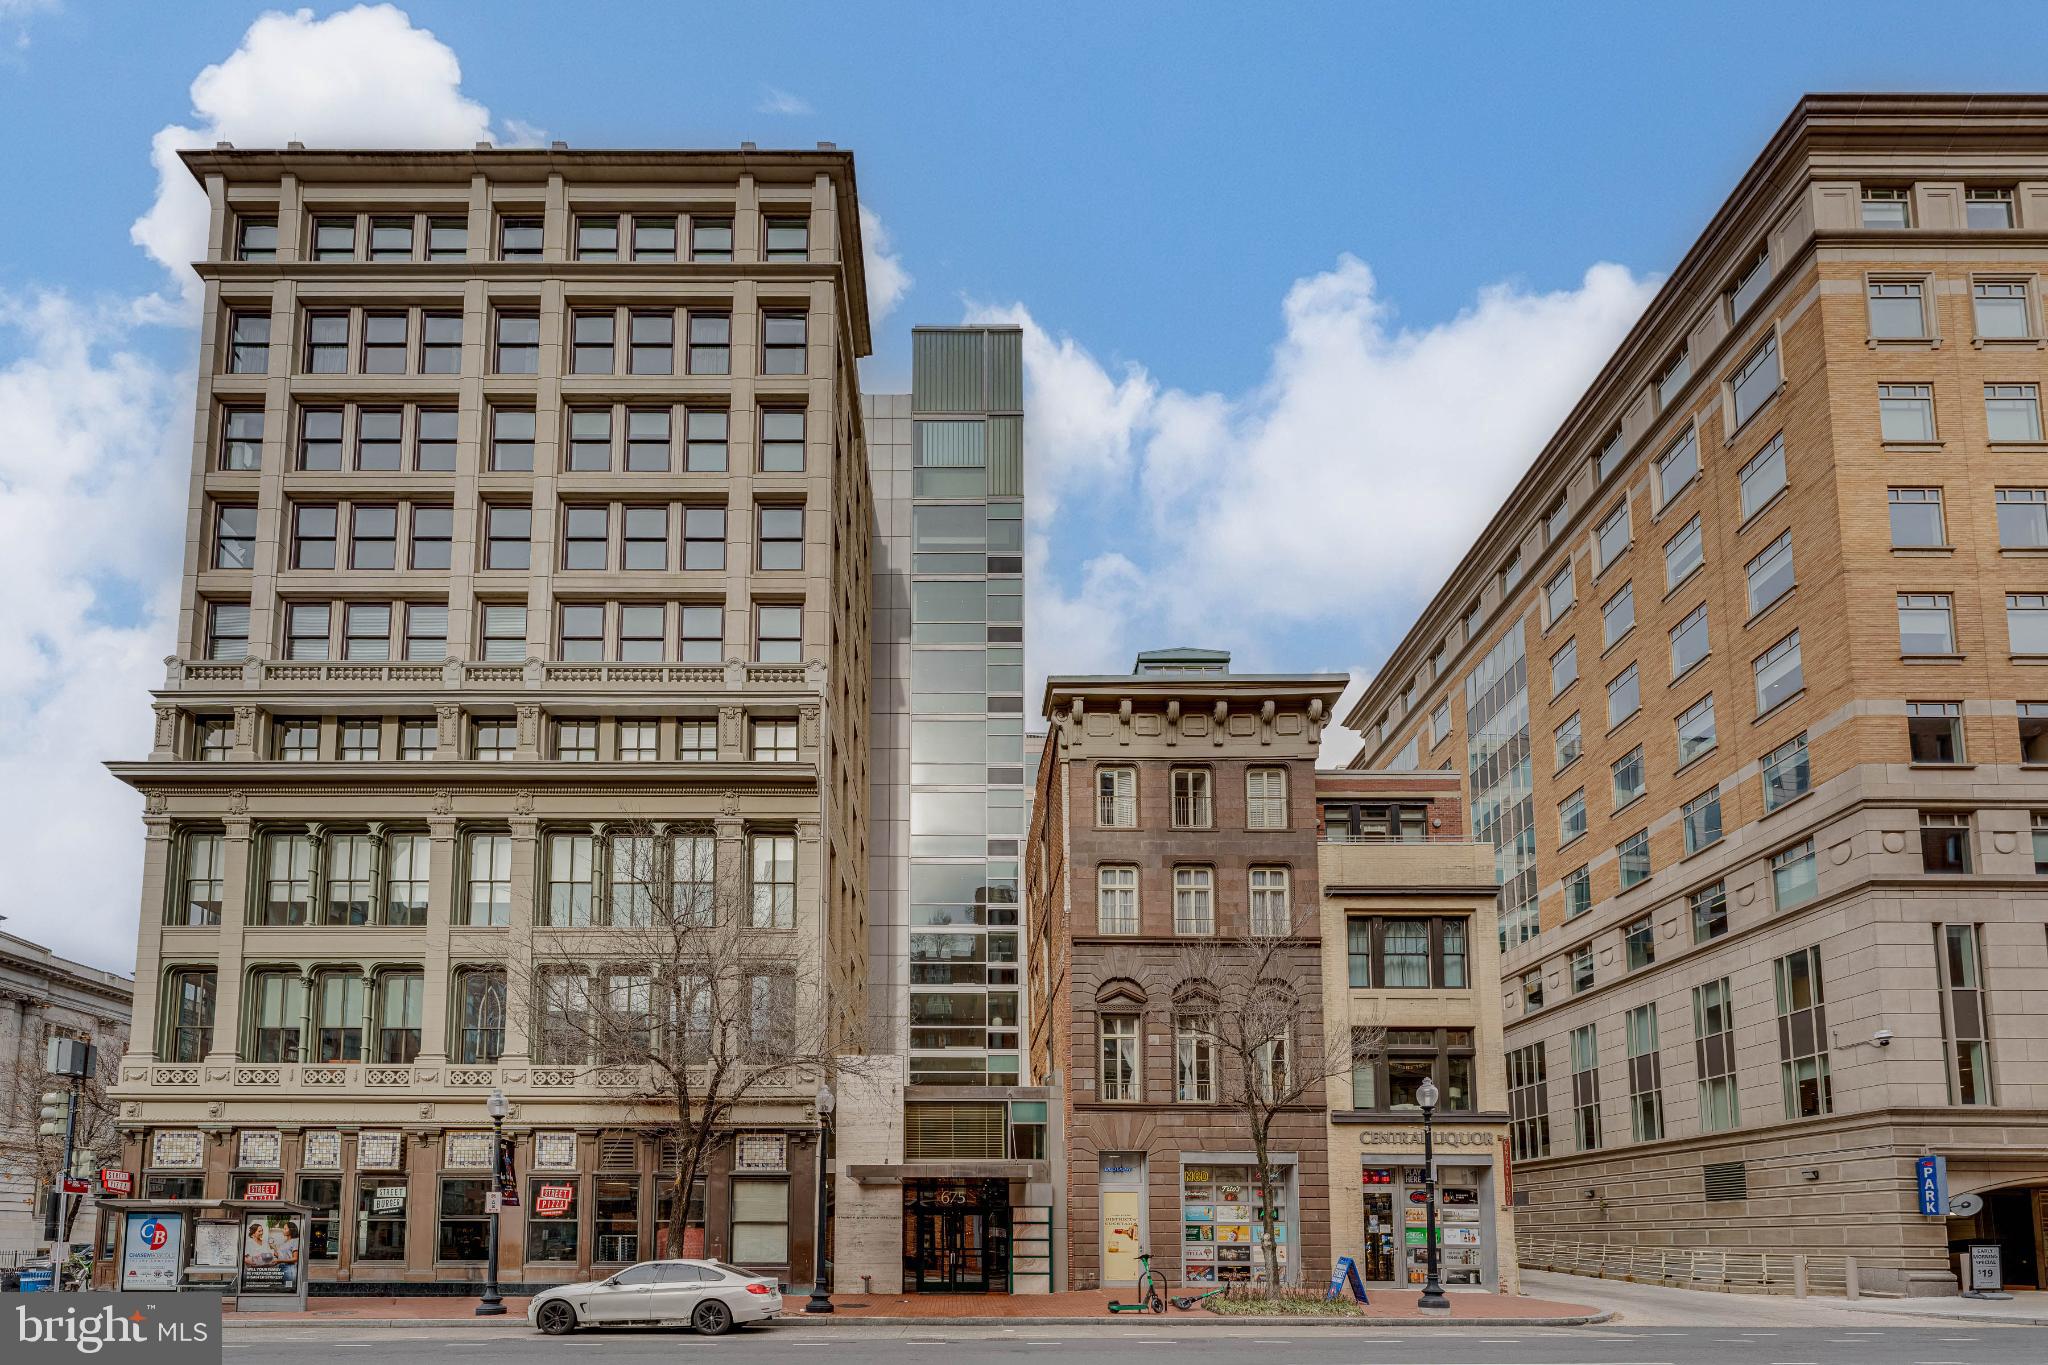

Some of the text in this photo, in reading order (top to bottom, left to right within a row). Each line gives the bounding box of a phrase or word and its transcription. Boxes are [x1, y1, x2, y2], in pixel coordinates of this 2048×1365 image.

[1433, 1131, 1493, 1148] LIQUOR
[1405, 1168, 1421, 1176] PLAY
[251, 1185, 275, 1194] STREET
[379, 1188, 404, 1196] STREET
[544, 1190, 569, 1198] STREET
[1923, 1167, 1936, 1213] PARK
[941, 1190, 966, 1204] 675
[376, 1199, 400, 1208] BURGER
[542, 1200, 564, 1208] PIZZA
[141, 1223, 166, 1245] CB
